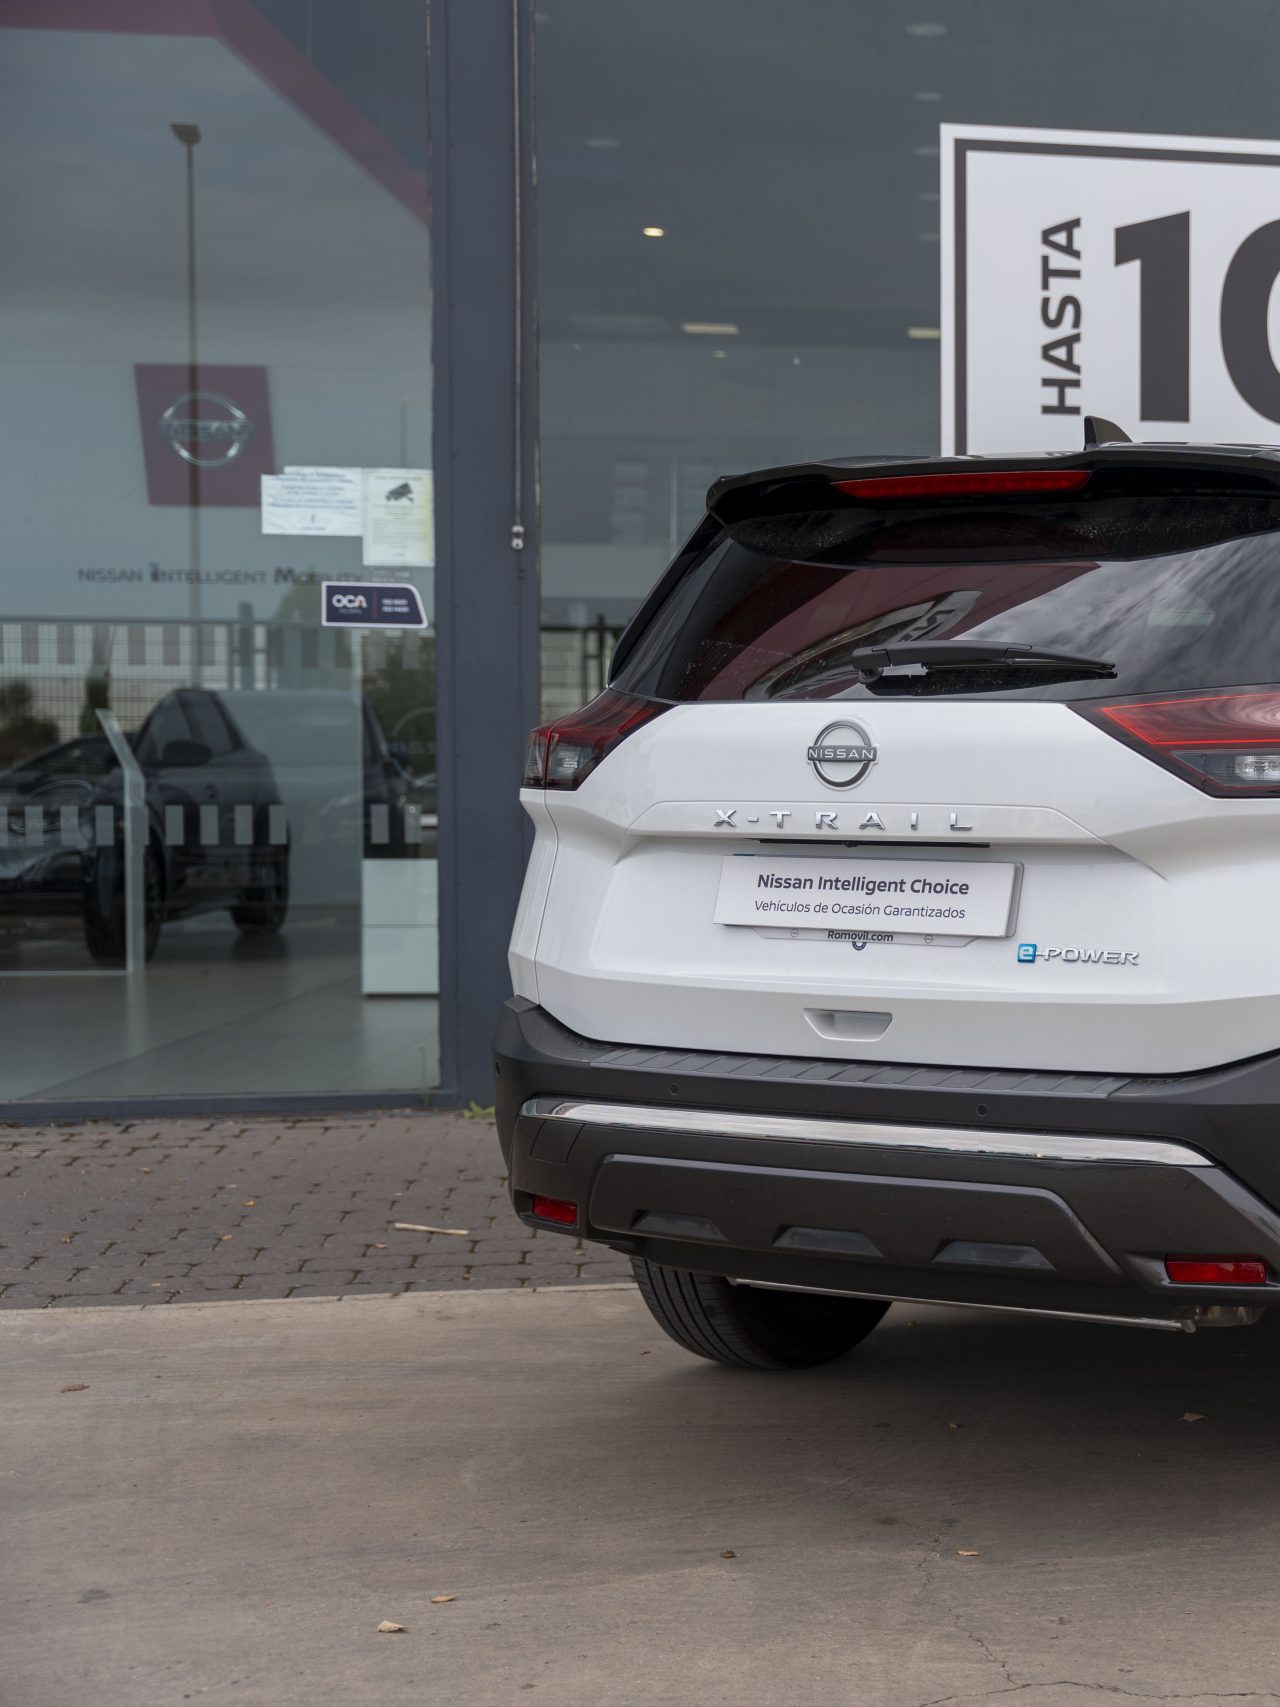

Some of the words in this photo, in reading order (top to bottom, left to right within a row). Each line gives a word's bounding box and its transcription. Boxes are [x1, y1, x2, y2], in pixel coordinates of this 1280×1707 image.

[1041, 217, 1082, 416] HASTA
[77, 567, 143, 584] NISSAN
[332, 594, 368, 609] OCA
[808, 747, 875, 760] NISSAN
[713, 808, 973, 832] X-TRAIL
[757, 873, 814, 891] Nissan
[817, 875, 907, 896] Intelligent
[910, 878, 970, 896] Choice
[754, 899, 811, 914] Vehículos
[813, 902, 829, 915] de
[831, 902, 881, 917] Ocasión
[883, 904, 966, 919] Garantizados
[827, 930, 894, 942] Romovil.com
[1018, 943, 1140, 966] e-POWER
